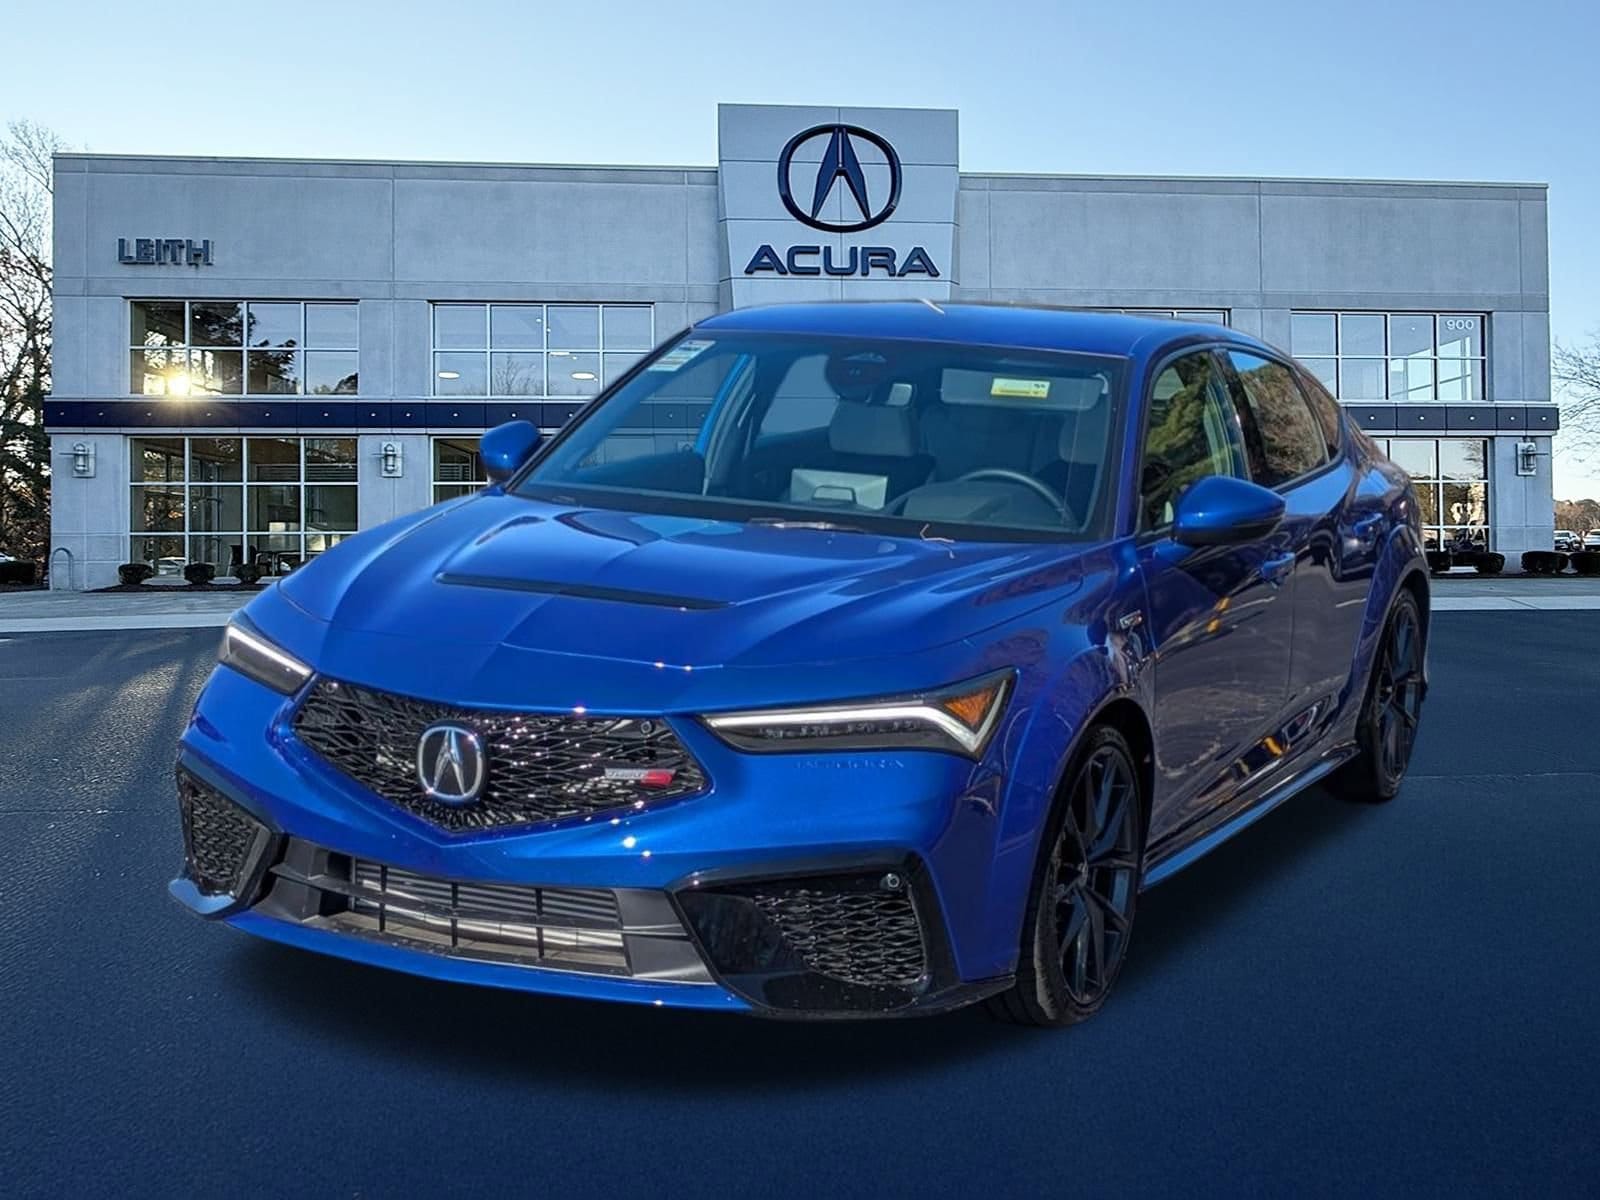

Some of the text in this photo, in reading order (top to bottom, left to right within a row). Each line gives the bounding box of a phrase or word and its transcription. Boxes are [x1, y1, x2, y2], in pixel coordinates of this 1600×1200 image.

[118, 238, 213, 265] LEITH
[743, 244, 940, 277] ACURA
[1446, 319, 1474, 330] 900
